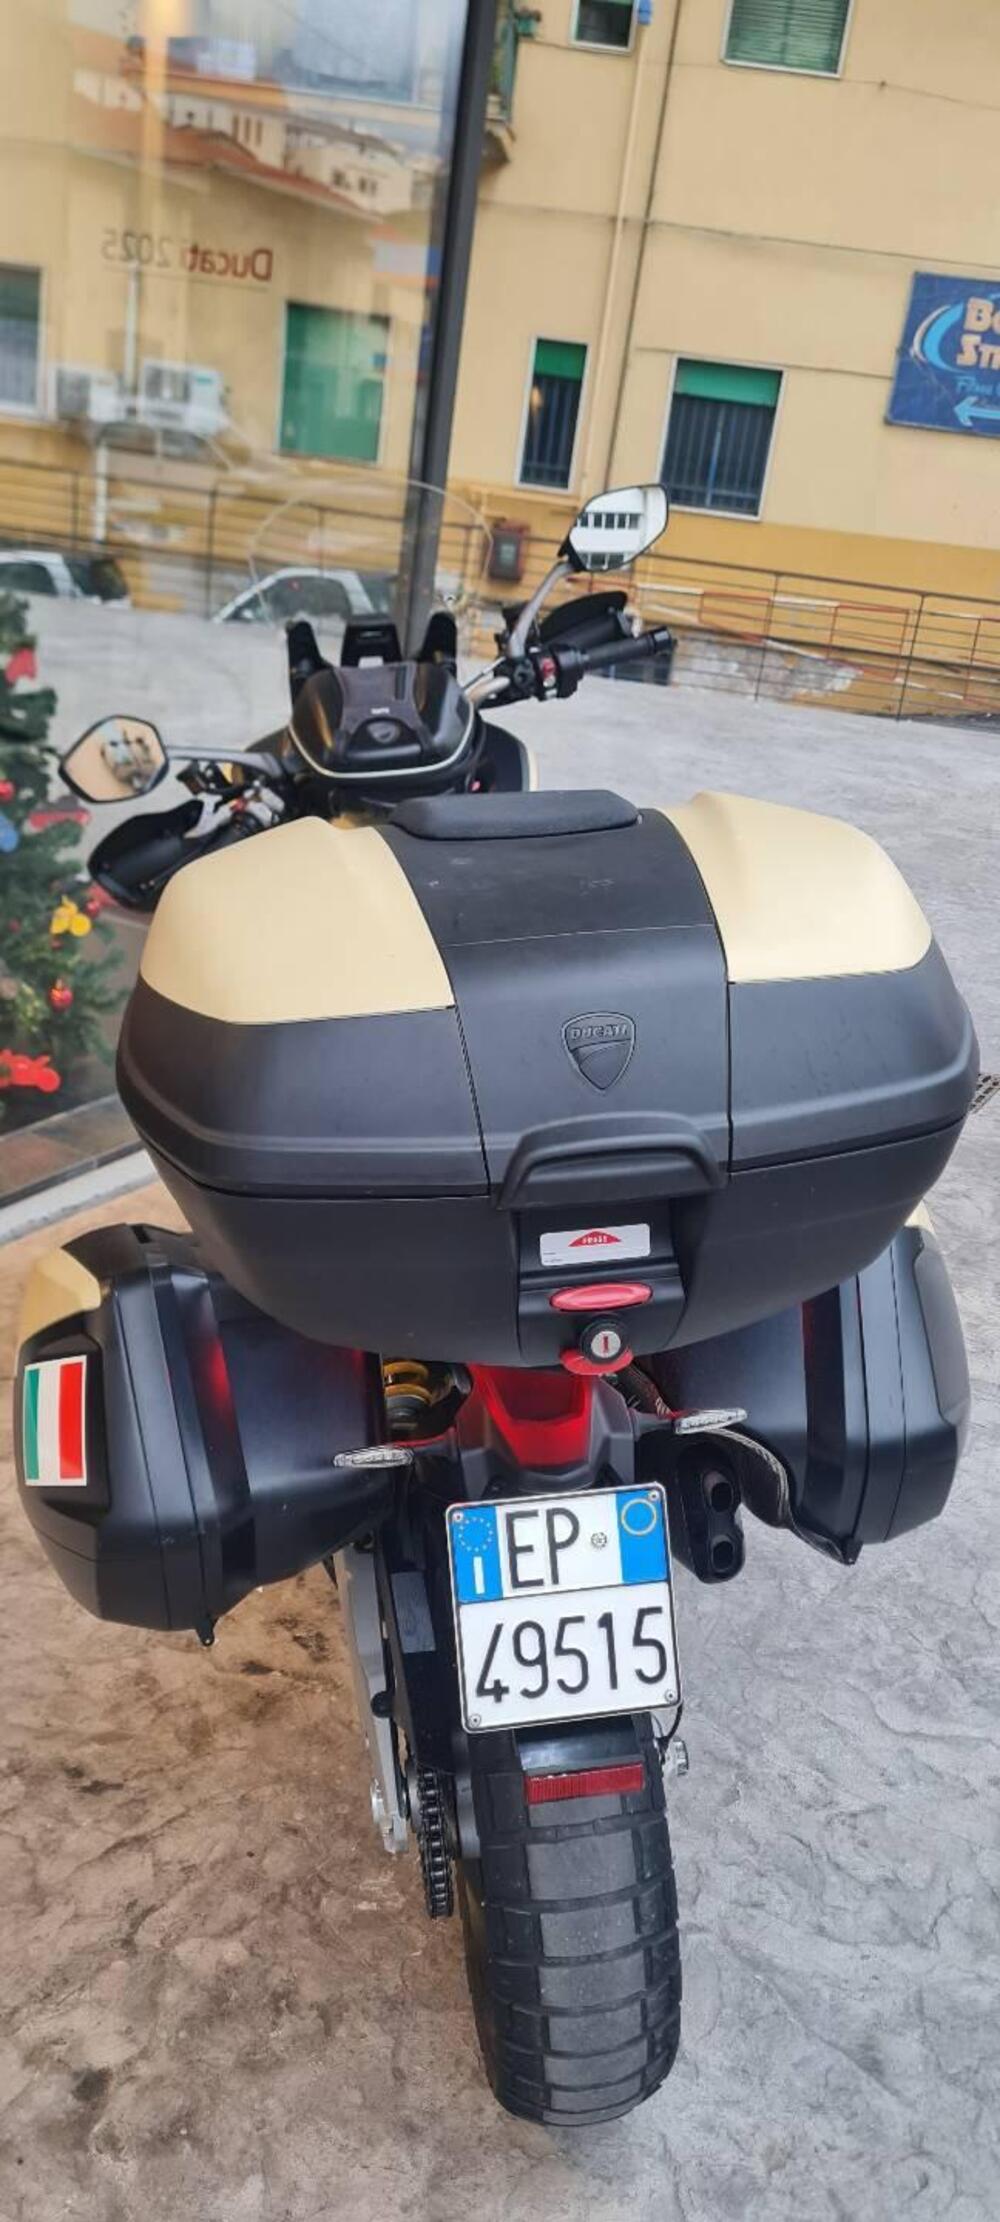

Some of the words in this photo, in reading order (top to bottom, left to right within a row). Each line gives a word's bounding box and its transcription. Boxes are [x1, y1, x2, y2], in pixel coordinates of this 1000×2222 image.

[571, 1023, 628, 1040] DUCATI
[473, 1556, 486, 1595] I
[505, 1507, 580, 1590] EP
[476, 1606, 668, 1703] 49515
